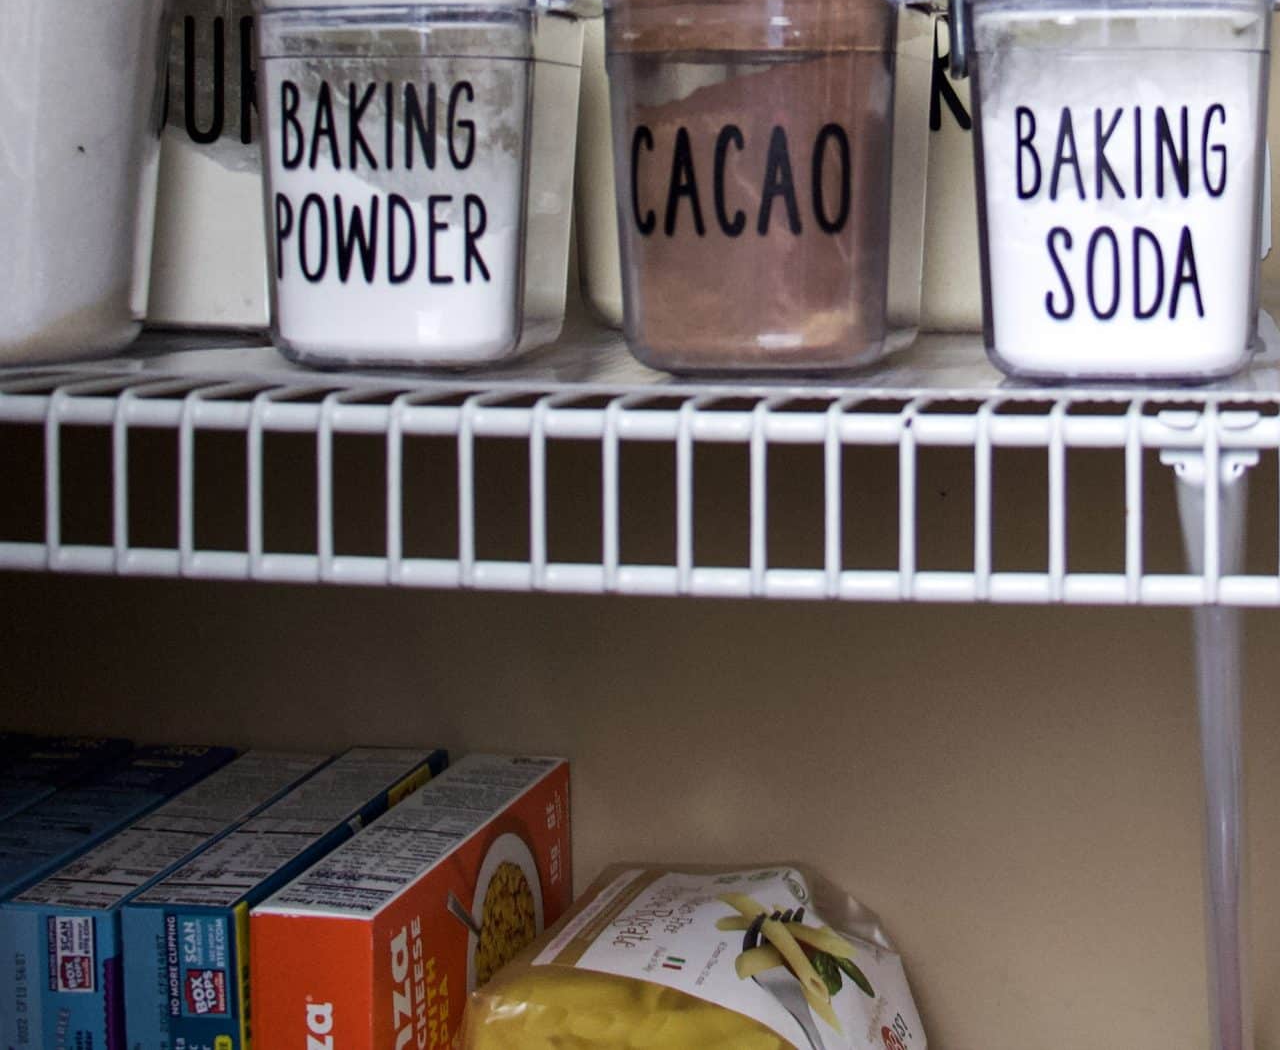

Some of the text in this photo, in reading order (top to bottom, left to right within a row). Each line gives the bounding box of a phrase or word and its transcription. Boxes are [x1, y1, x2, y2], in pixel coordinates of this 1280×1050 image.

[280, 80, 476, 172] BAKING
[1013, 102, 1228, 203] BAKING
[630, 122, 852, 239] CACAO
[275, 192, 491, 284] POWDER
[1044, 225, 1205, 322] SODA
[166, 916, 180, 1015] NO MORE CLIPPING
[183, 921, 197, 963] SCAN
[410, 915, 428, 1050] CHEESE
[190, 976, 209, 1014] BOX
[202, 970, 217, 1009] TOPS
